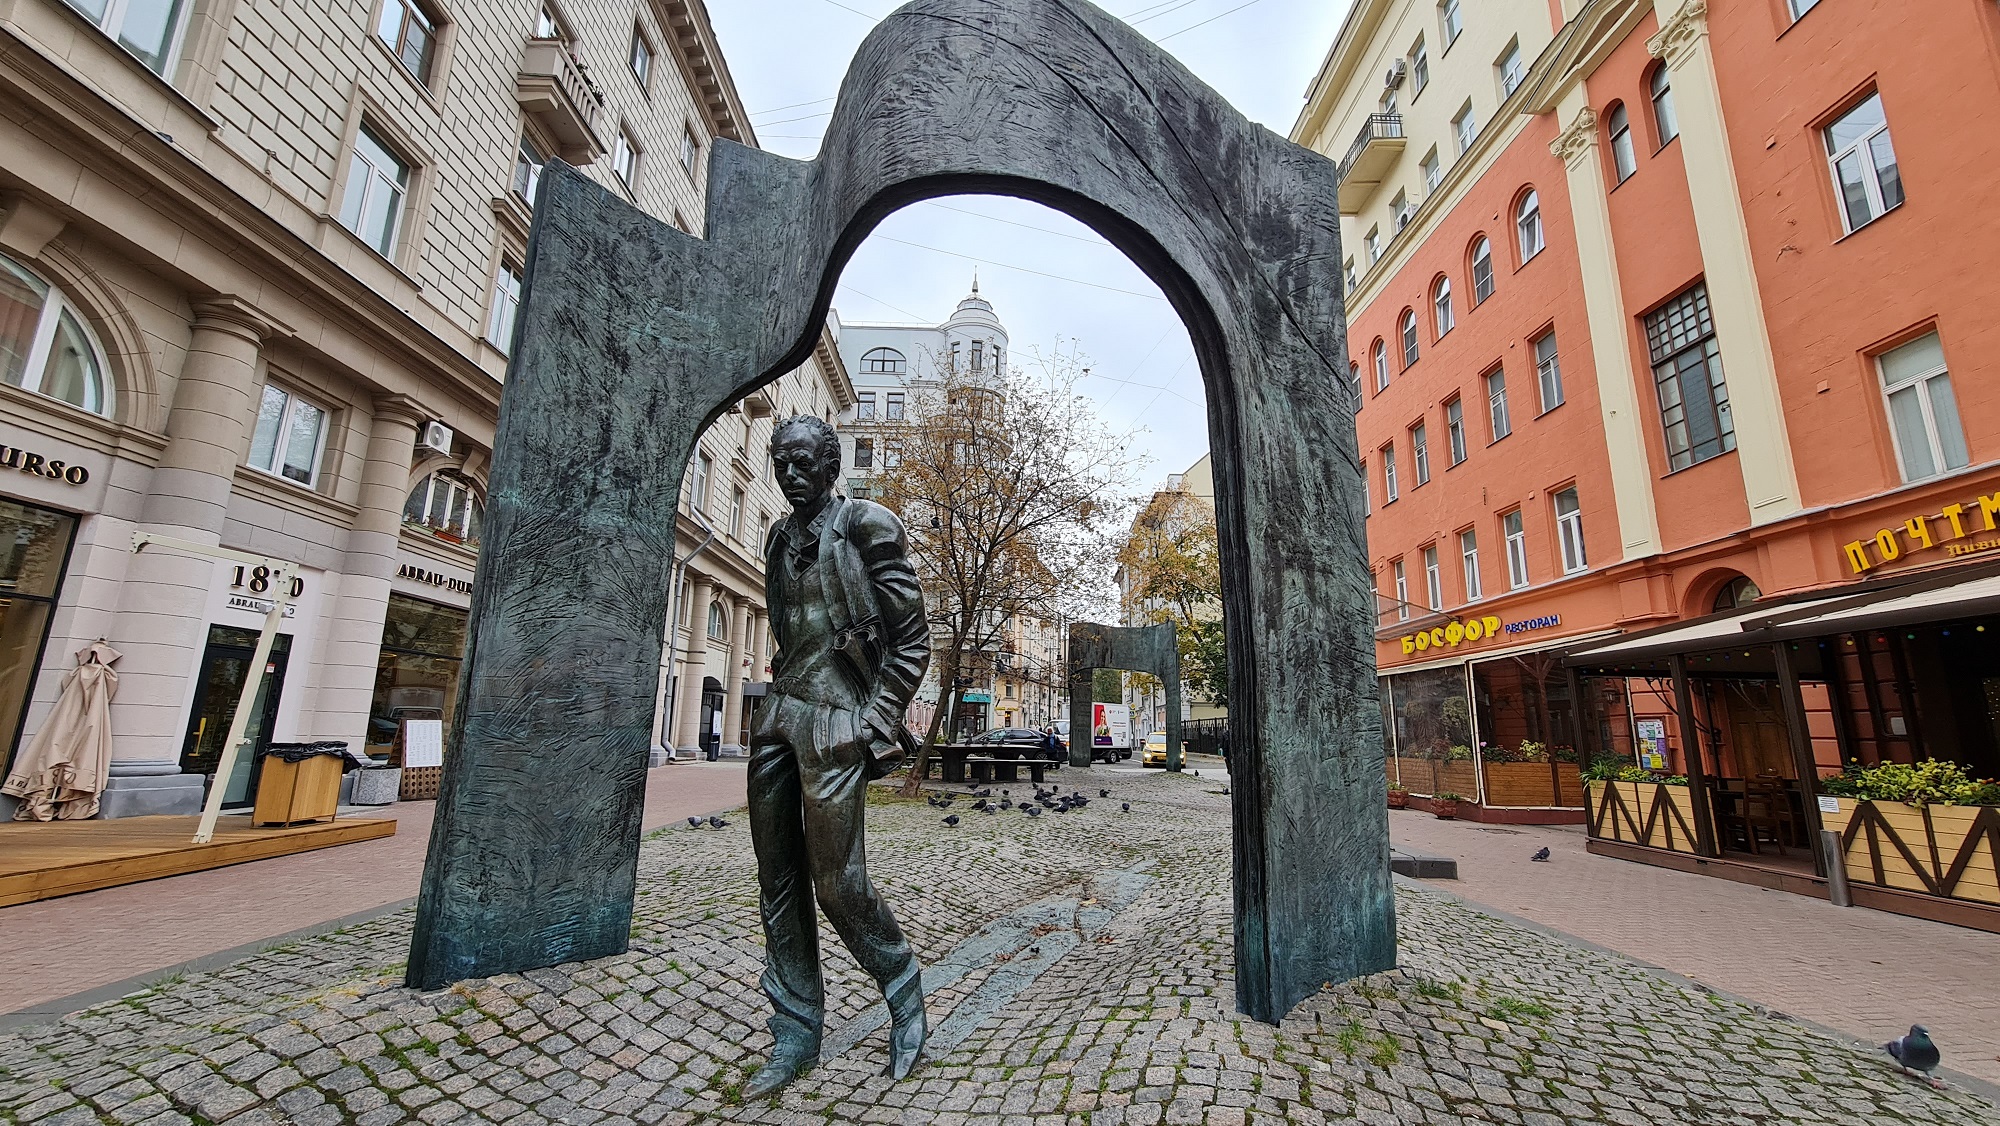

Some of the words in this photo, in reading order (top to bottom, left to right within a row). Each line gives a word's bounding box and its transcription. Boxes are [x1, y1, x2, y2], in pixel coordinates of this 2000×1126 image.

[230, 565, 304, 598] 180
[1400, 615, 1500, 655] БОСФОР
[1505, 614, 1561, 634] РЕСТОРАН
